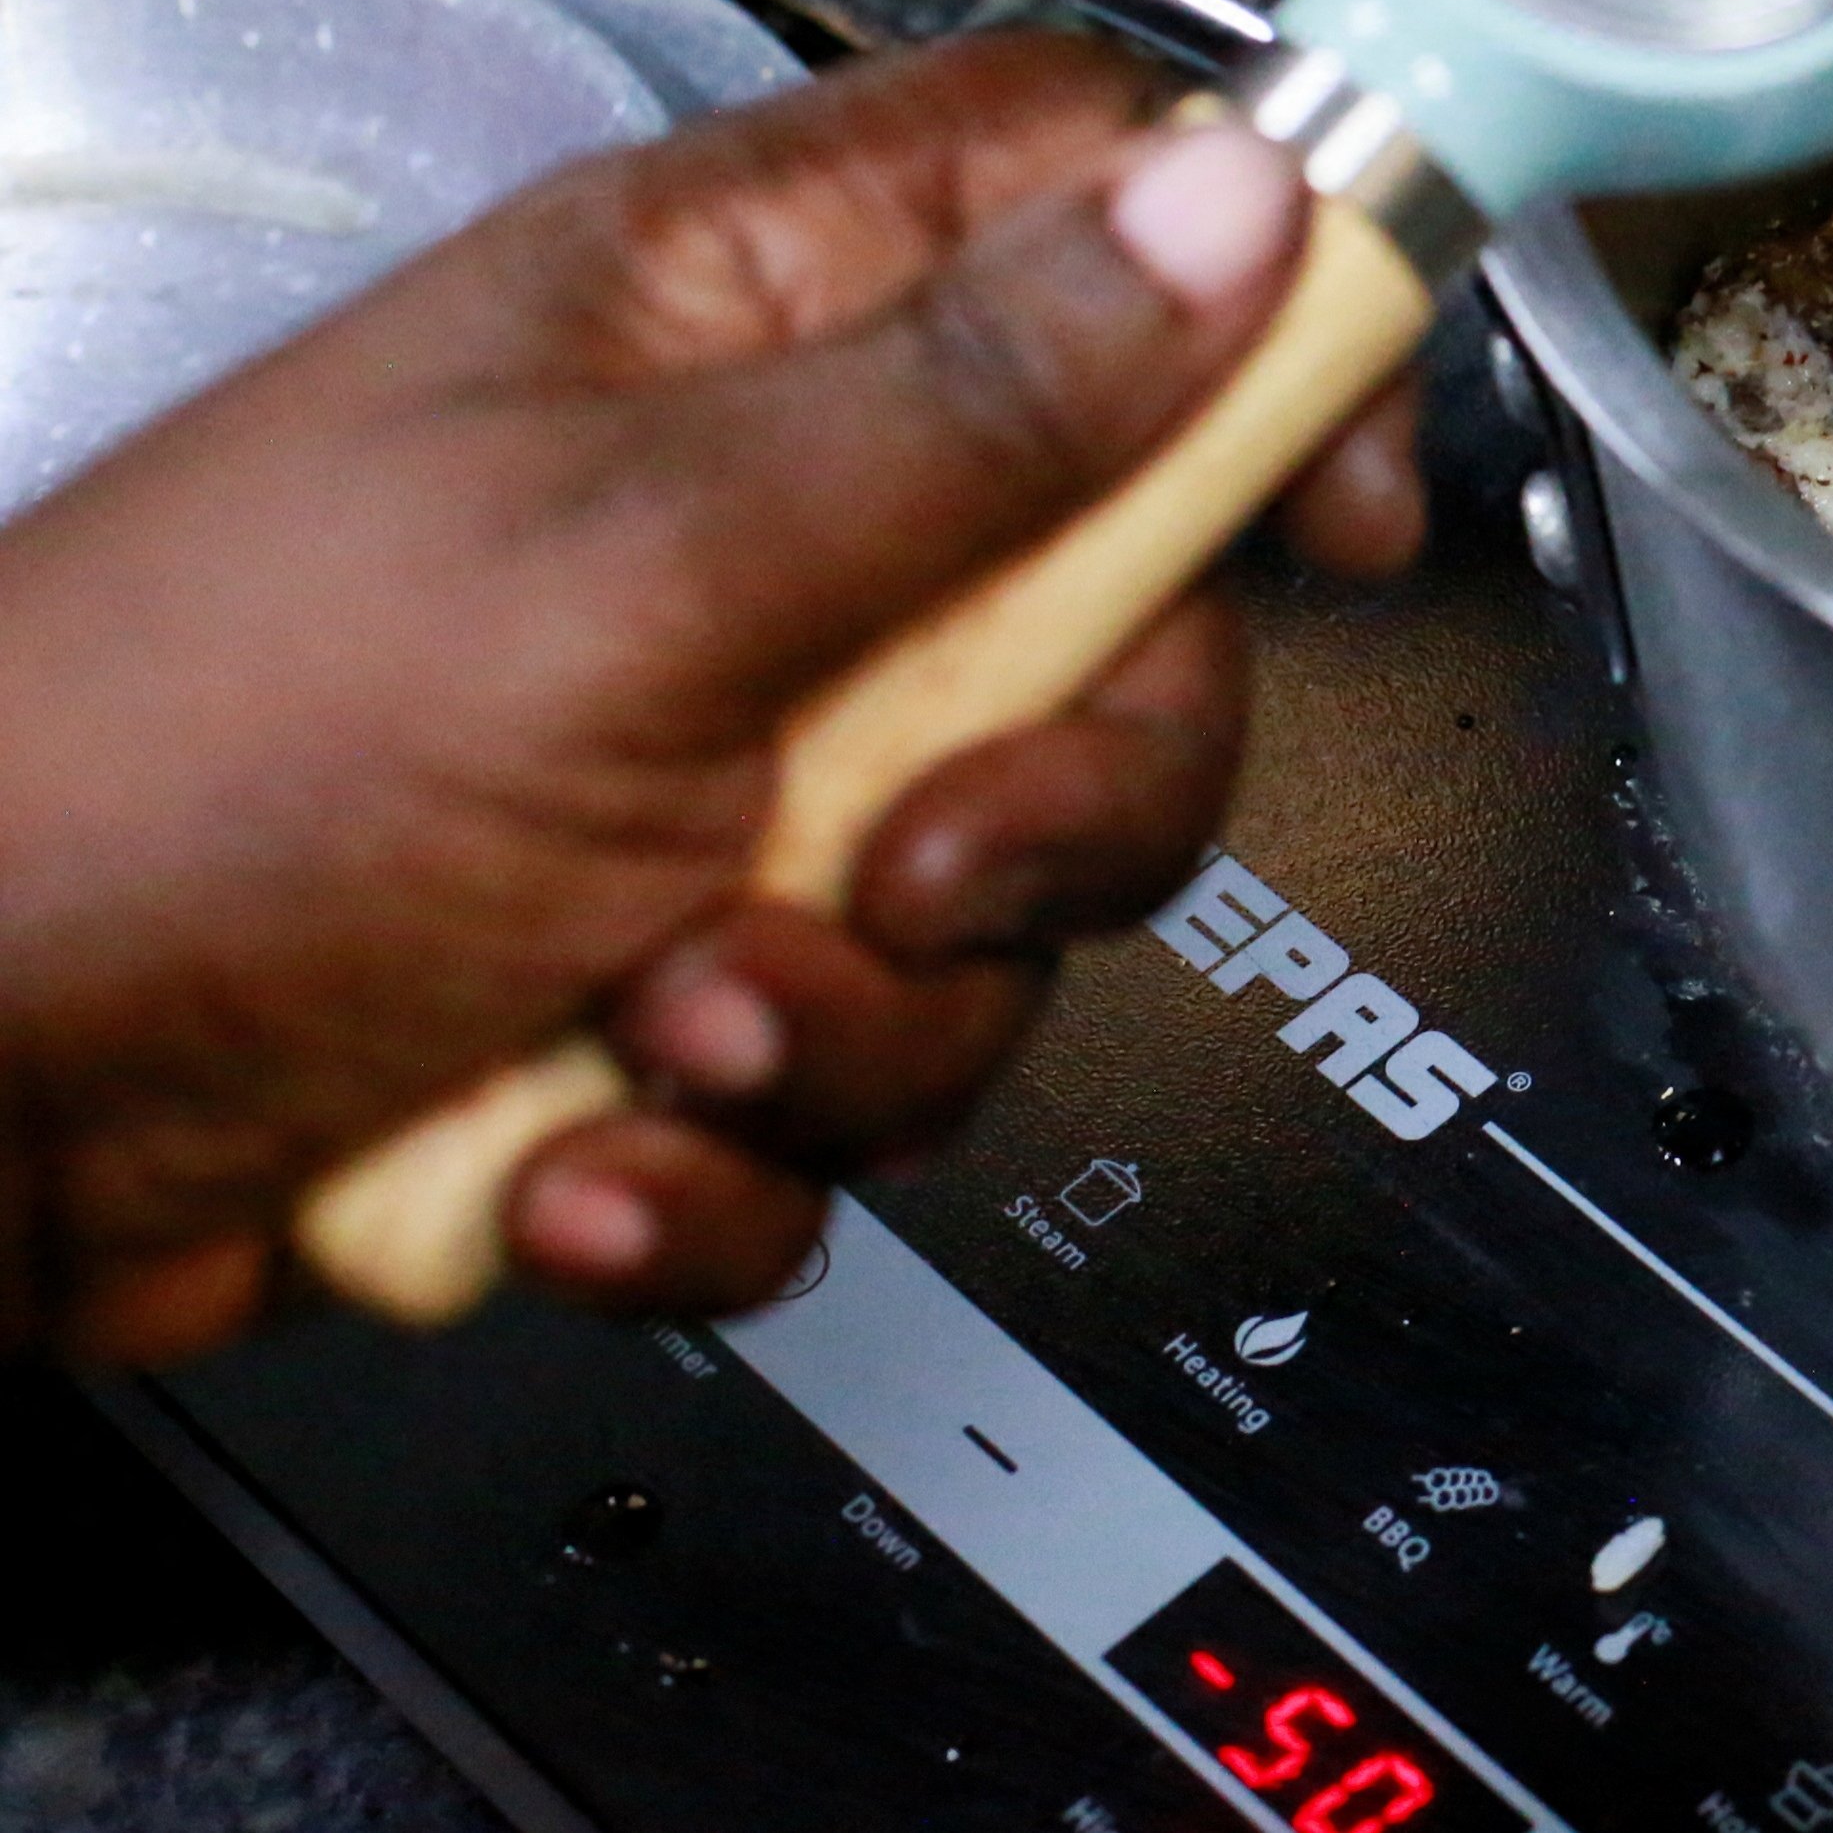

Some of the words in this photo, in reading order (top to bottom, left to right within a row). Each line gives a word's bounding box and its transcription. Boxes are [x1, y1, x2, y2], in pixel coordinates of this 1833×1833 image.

[1003, 1194, 1087, 1270] Steam
[643, 1322, 718, 1379] imer
[1162, 1332, 1272, 1434] Heating
[841, 1492, 922, 1571] Down
[1362, 1505, 1431, 1572] BBQ
[1527, 1643, 1614, 1728] Warm
